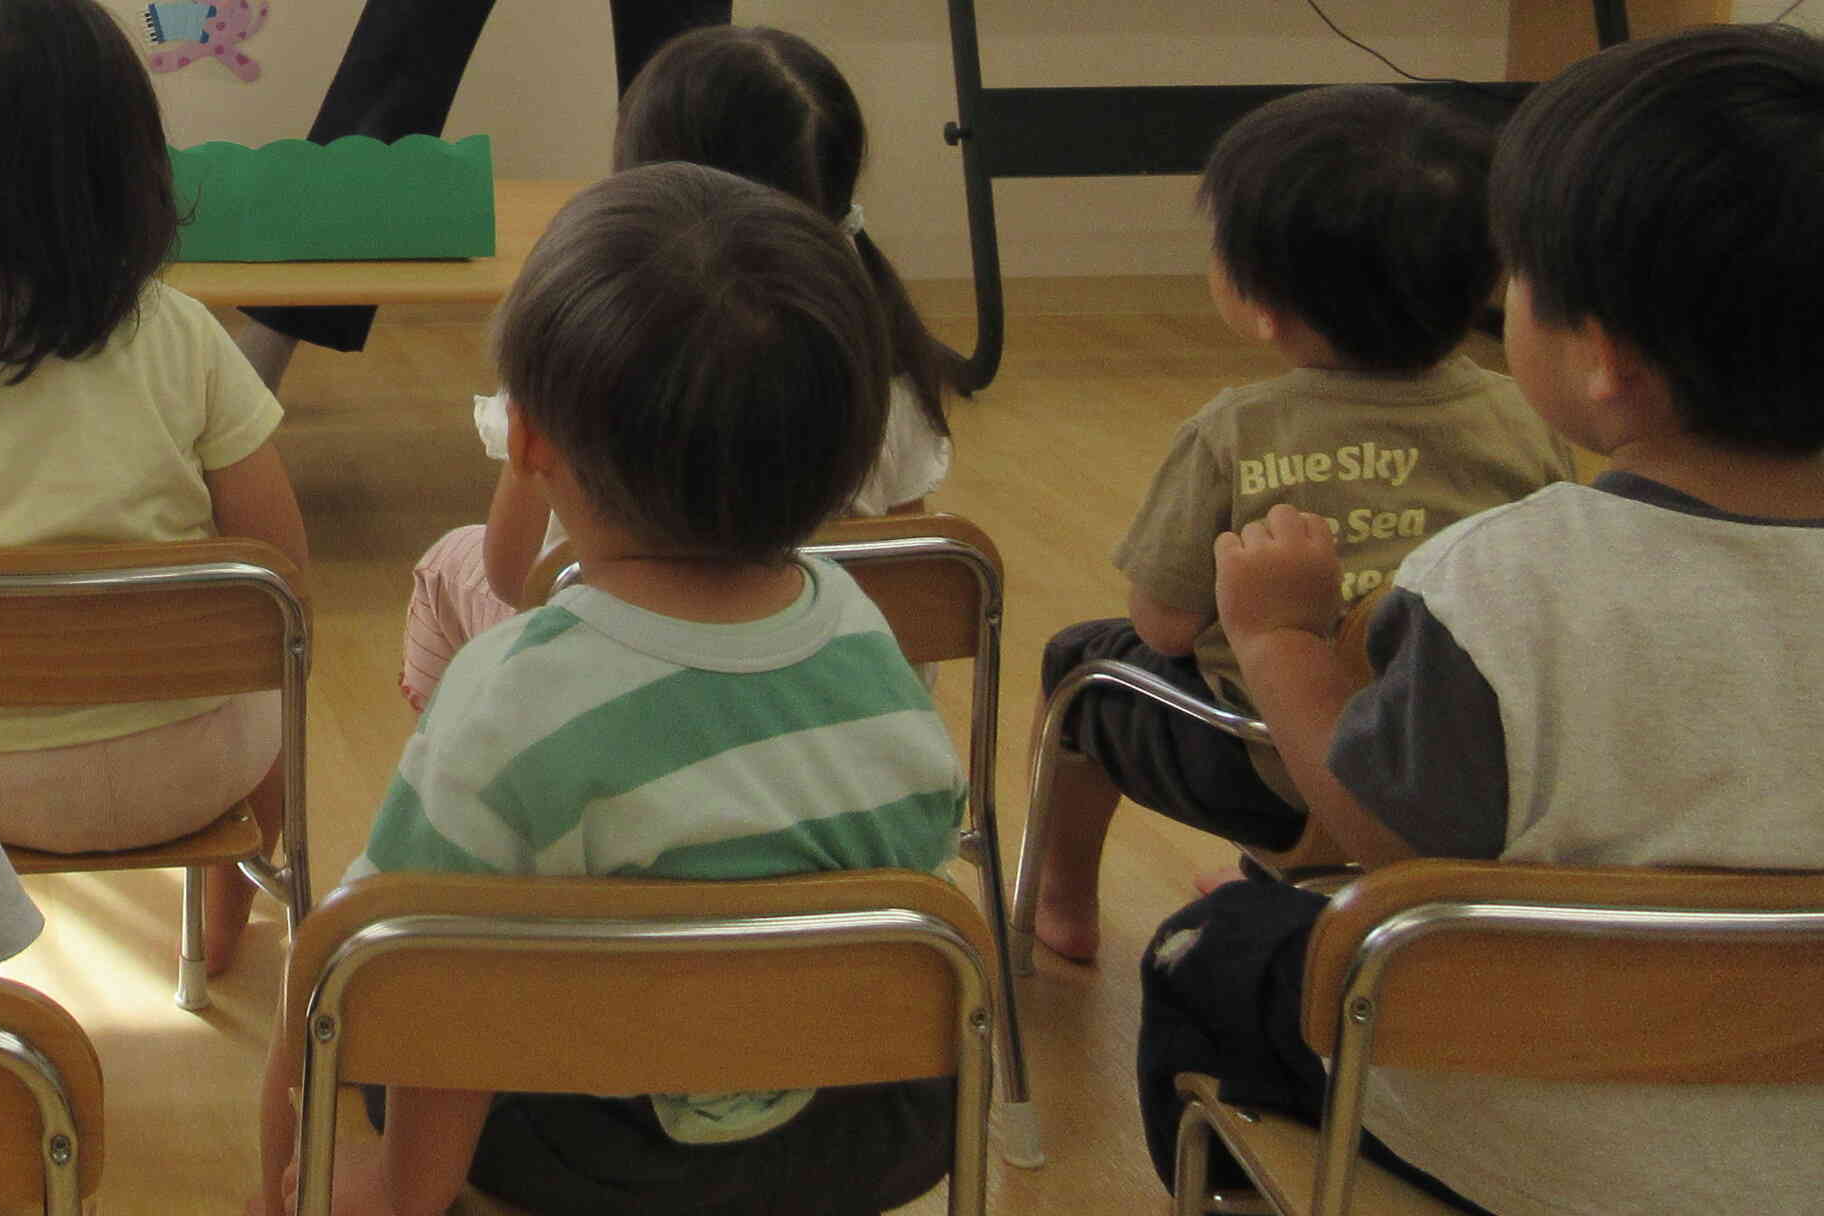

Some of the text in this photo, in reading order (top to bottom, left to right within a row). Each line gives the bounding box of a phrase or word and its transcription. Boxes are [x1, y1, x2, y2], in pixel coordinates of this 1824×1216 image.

[1238, 442, 1420, 496] Blue Sky
[1345, 507, 1426, 544] Sea
